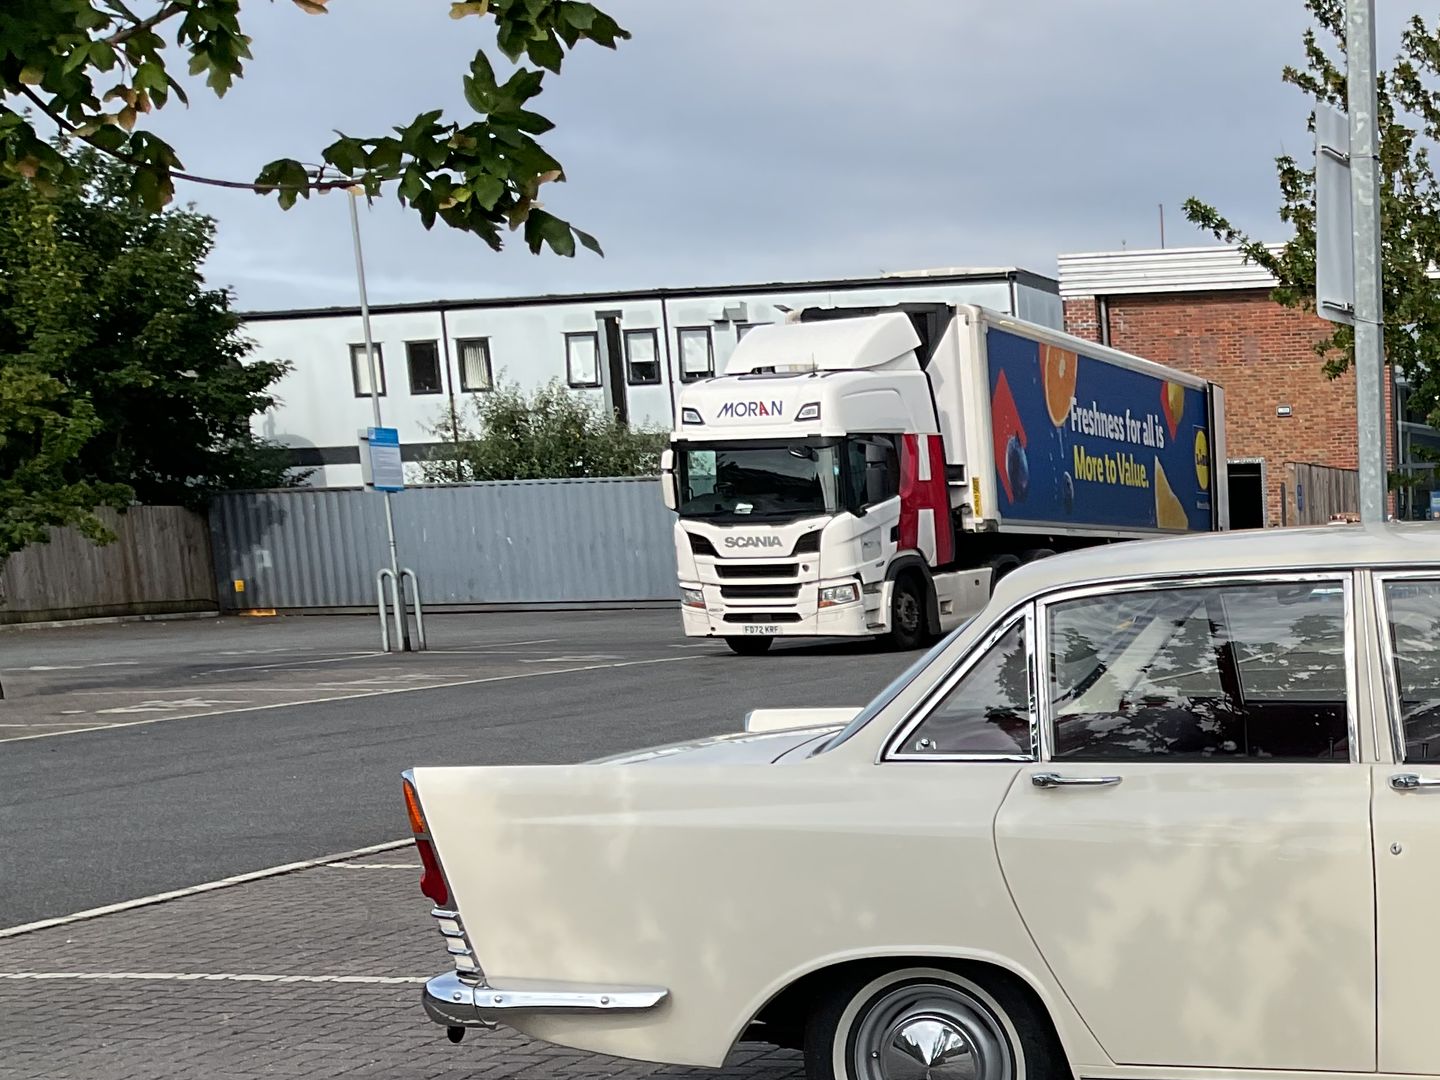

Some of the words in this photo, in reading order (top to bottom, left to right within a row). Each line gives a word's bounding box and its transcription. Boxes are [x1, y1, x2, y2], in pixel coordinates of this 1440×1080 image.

[717, 400, 783, 418] MORAN
[1070, 397, 1125, 442] Freshness
[1125, 408, 1141, 445] for
[1142, 413, 1155, 448] all
[1155, 414, 1165, 449] is
[1073, 444, 1104, 483] More
[1104, 453, 1117, 485] to
[1116, 451, 1150, 489] Value.
[724, 535, 783, 549] SCANIA
